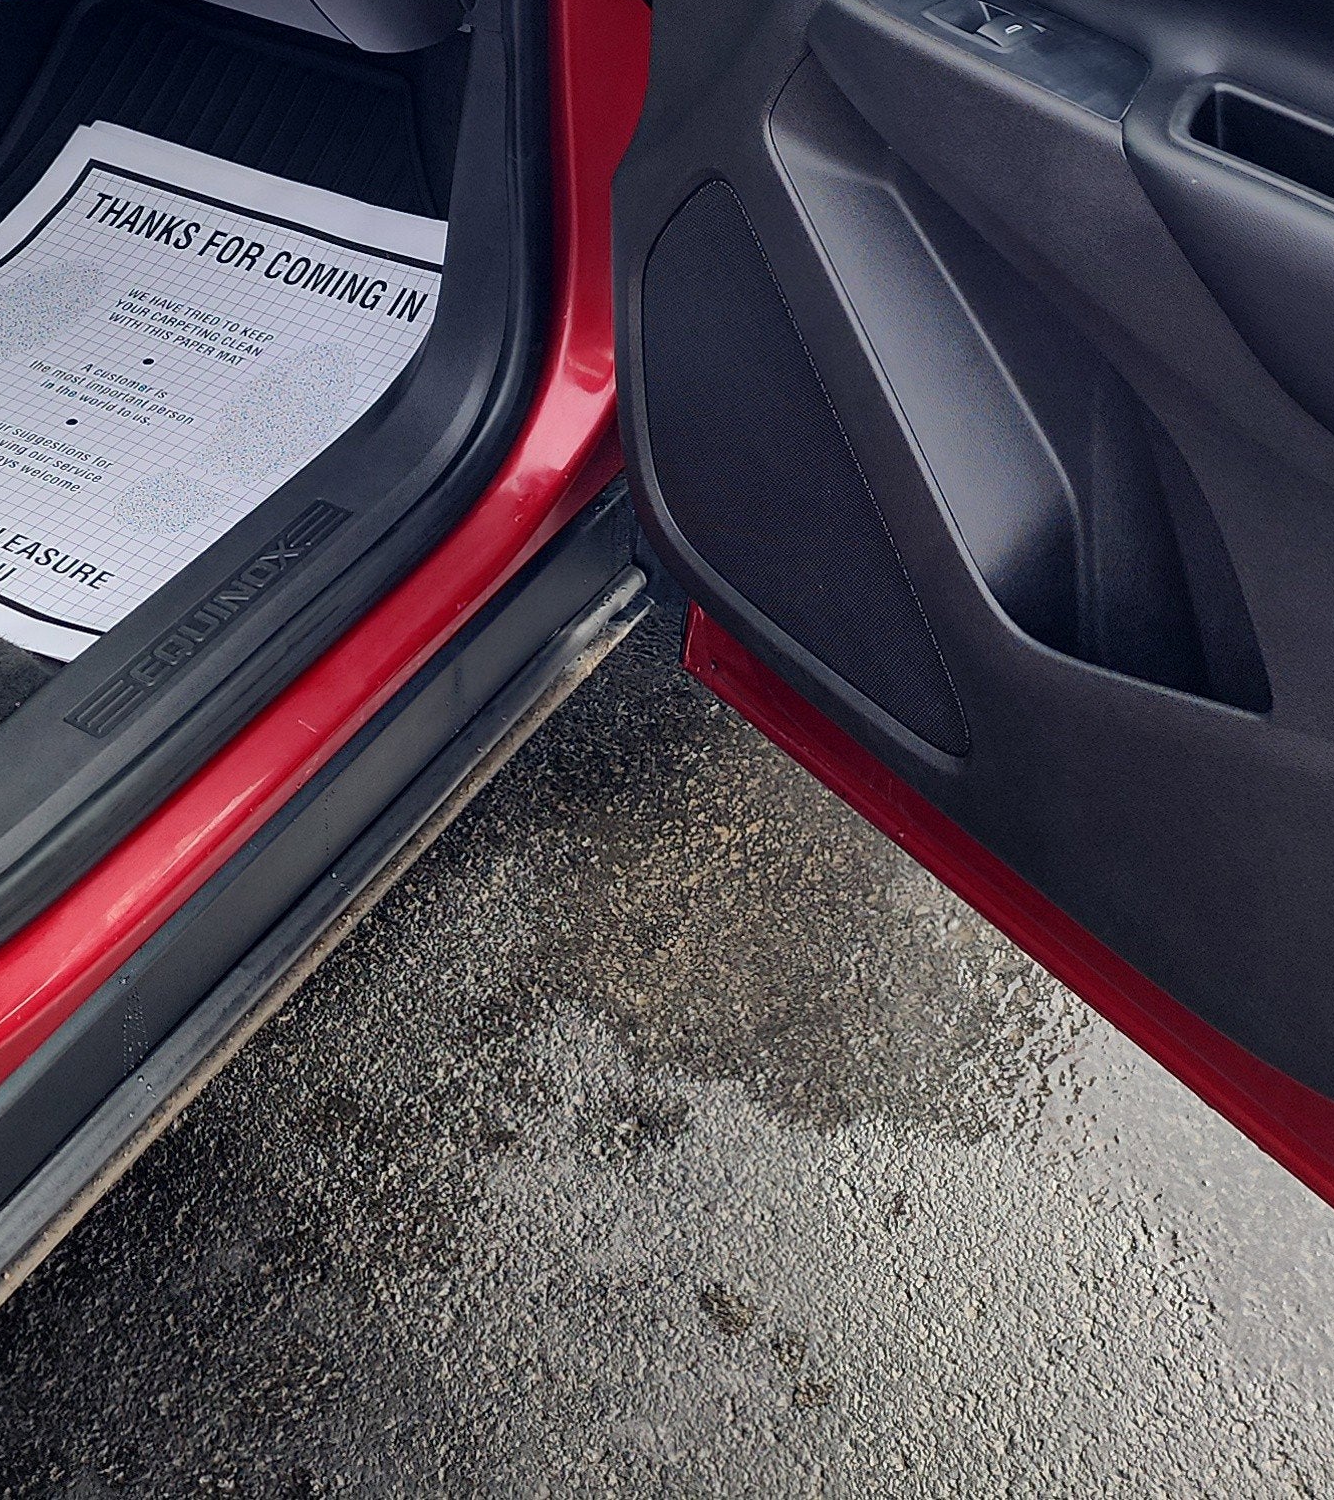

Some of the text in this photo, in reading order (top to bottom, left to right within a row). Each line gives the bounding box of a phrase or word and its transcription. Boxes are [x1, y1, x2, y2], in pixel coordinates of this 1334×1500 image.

[85, 192, 429, 323] THANKS FOR COMING IN
[108, 311, 245, 367] WITH THIS PAPER MAT
[114, 298, 264, 357] YOUR CARPETING CLEAN
[127, 288, 275, 344] WE HAVE TRIED TO KEEP
[29, 359, 195, 426] the most important person
[40, 379, 152, 427] in the world to us.
[80, 363, 168, 400] A customer is
[11, 426, 92, 462] suggestions
[92, 452, 115, 471] for
[28, 448, 53, 463] our
[53, 456, 103, 484] service
[21, 463, 83, 495] welcome.
[129, 538, 299, 687] EQUINOX
